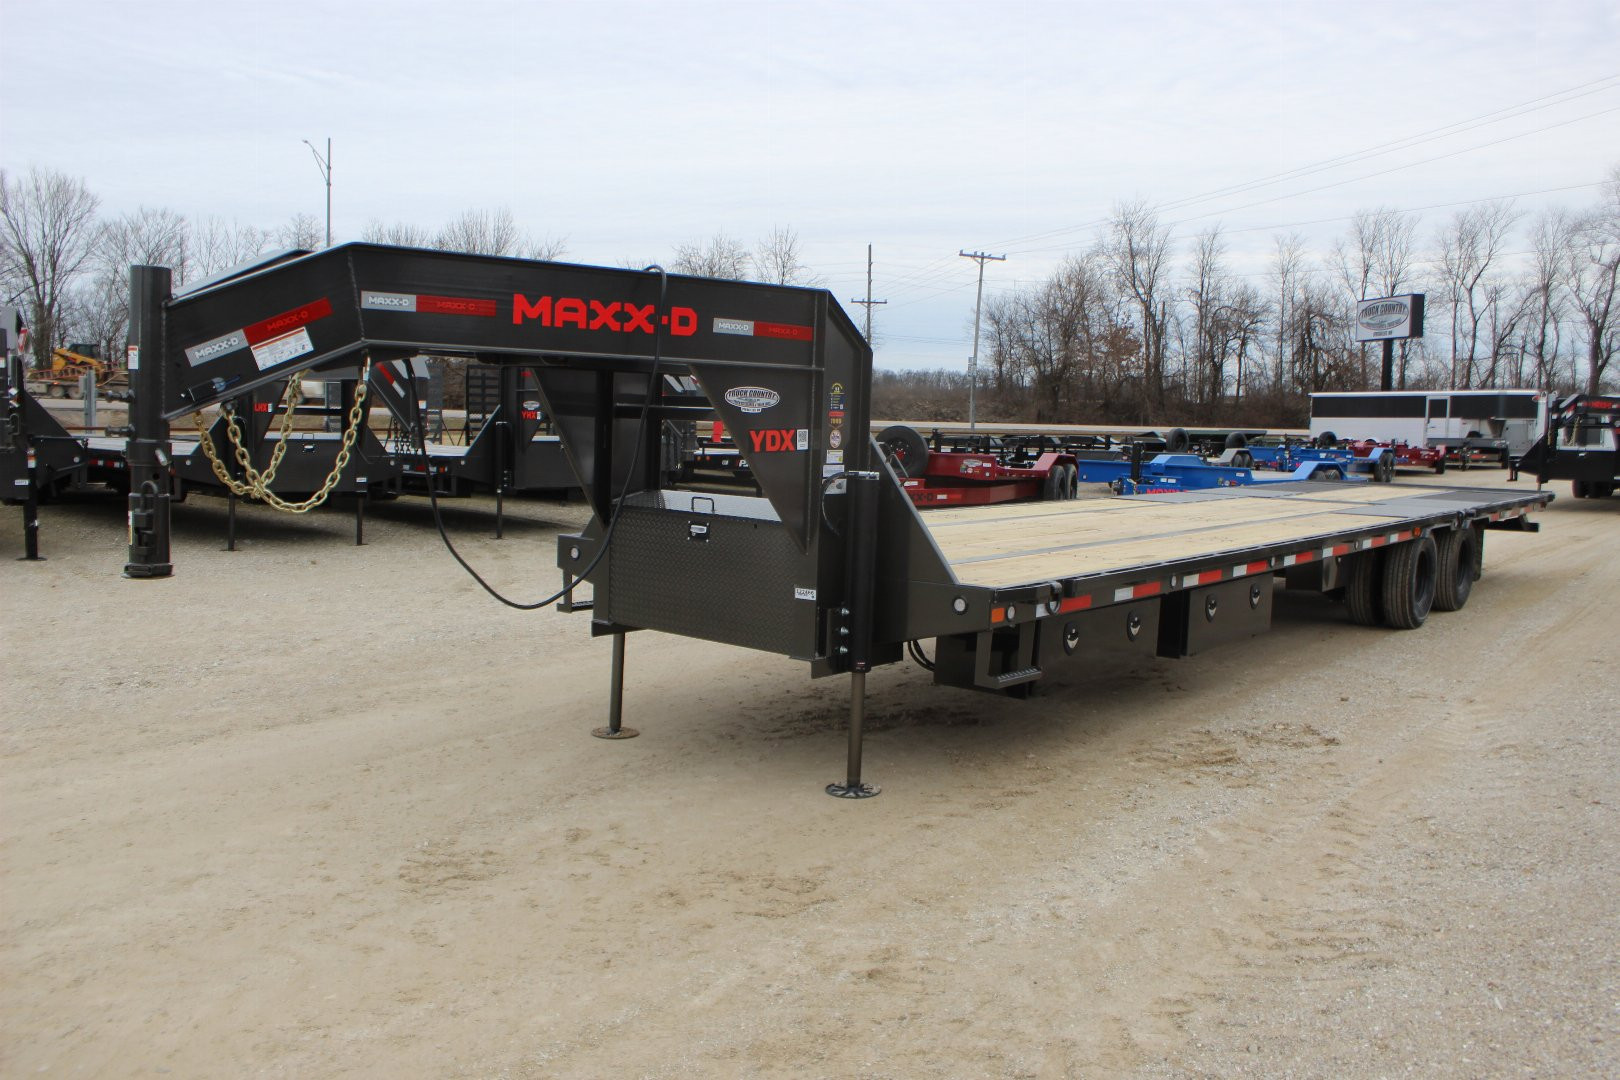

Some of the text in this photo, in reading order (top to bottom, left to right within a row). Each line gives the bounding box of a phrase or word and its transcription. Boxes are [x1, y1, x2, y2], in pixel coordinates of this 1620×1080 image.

[368, 296, 409, 306] MAXX-D
[512, 293, 698, 336] MAXX-D
[718, 322, 749, 331] MAXX-D
[194, 337, 239, 359] MAXX-D
[728, 389, 777, 400] TRUCK COUNTRY
[749, 429, 795, 452] YDX
